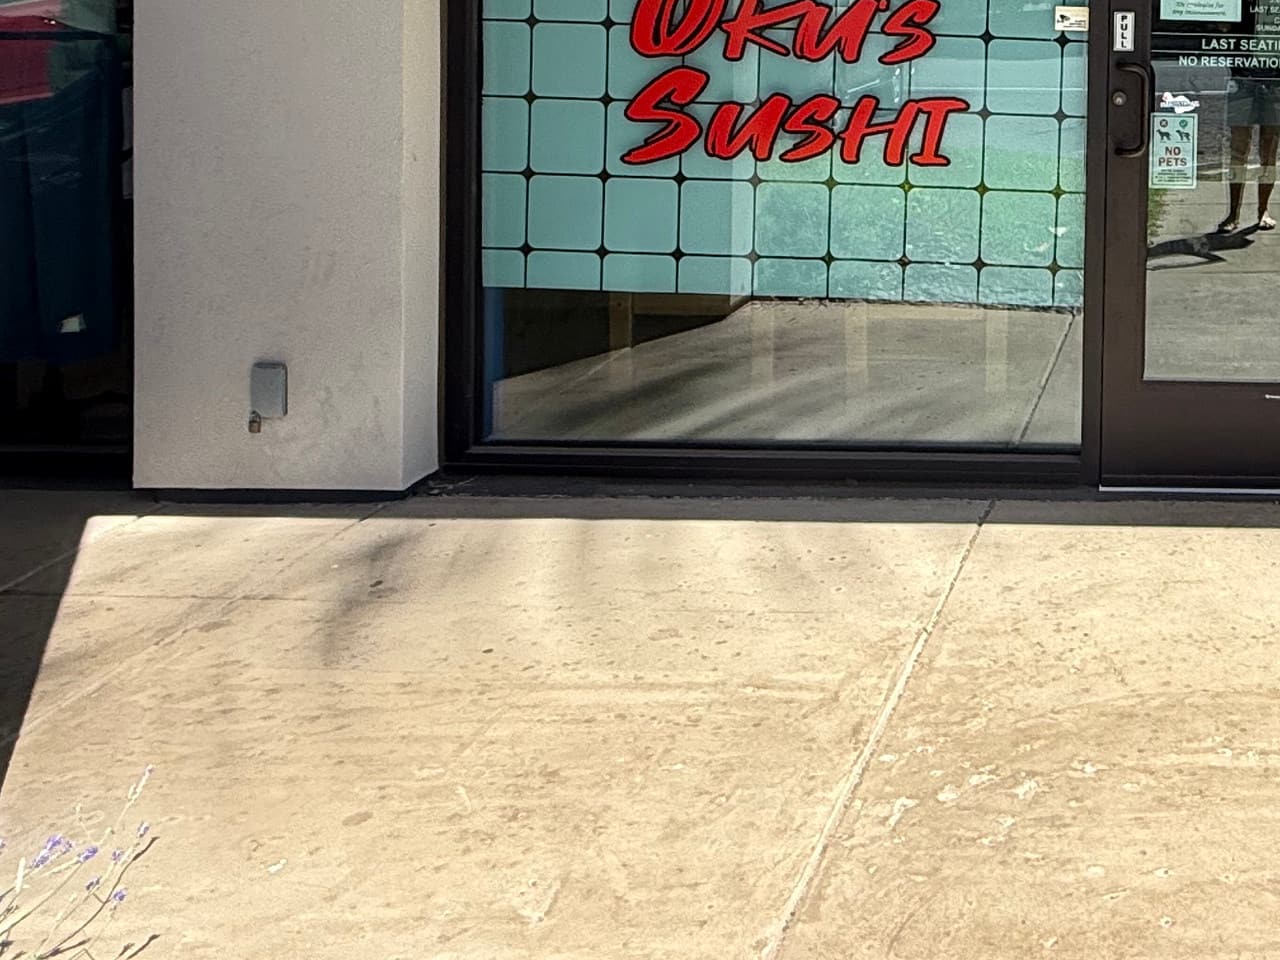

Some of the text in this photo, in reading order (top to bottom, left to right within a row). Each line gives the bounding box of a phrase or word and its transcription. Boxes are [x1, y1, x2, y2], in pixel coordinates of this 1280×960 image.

[1249, 5, 1267, 14] LAST
[1120, 15, 1128, 48] PULL
[1201, 38, 1236, 50] LAST
[1178, 55, 1198, 66] NO
[1165, 146, 1182, 156] NO
[1158, 157, 1188, 167] PETS
